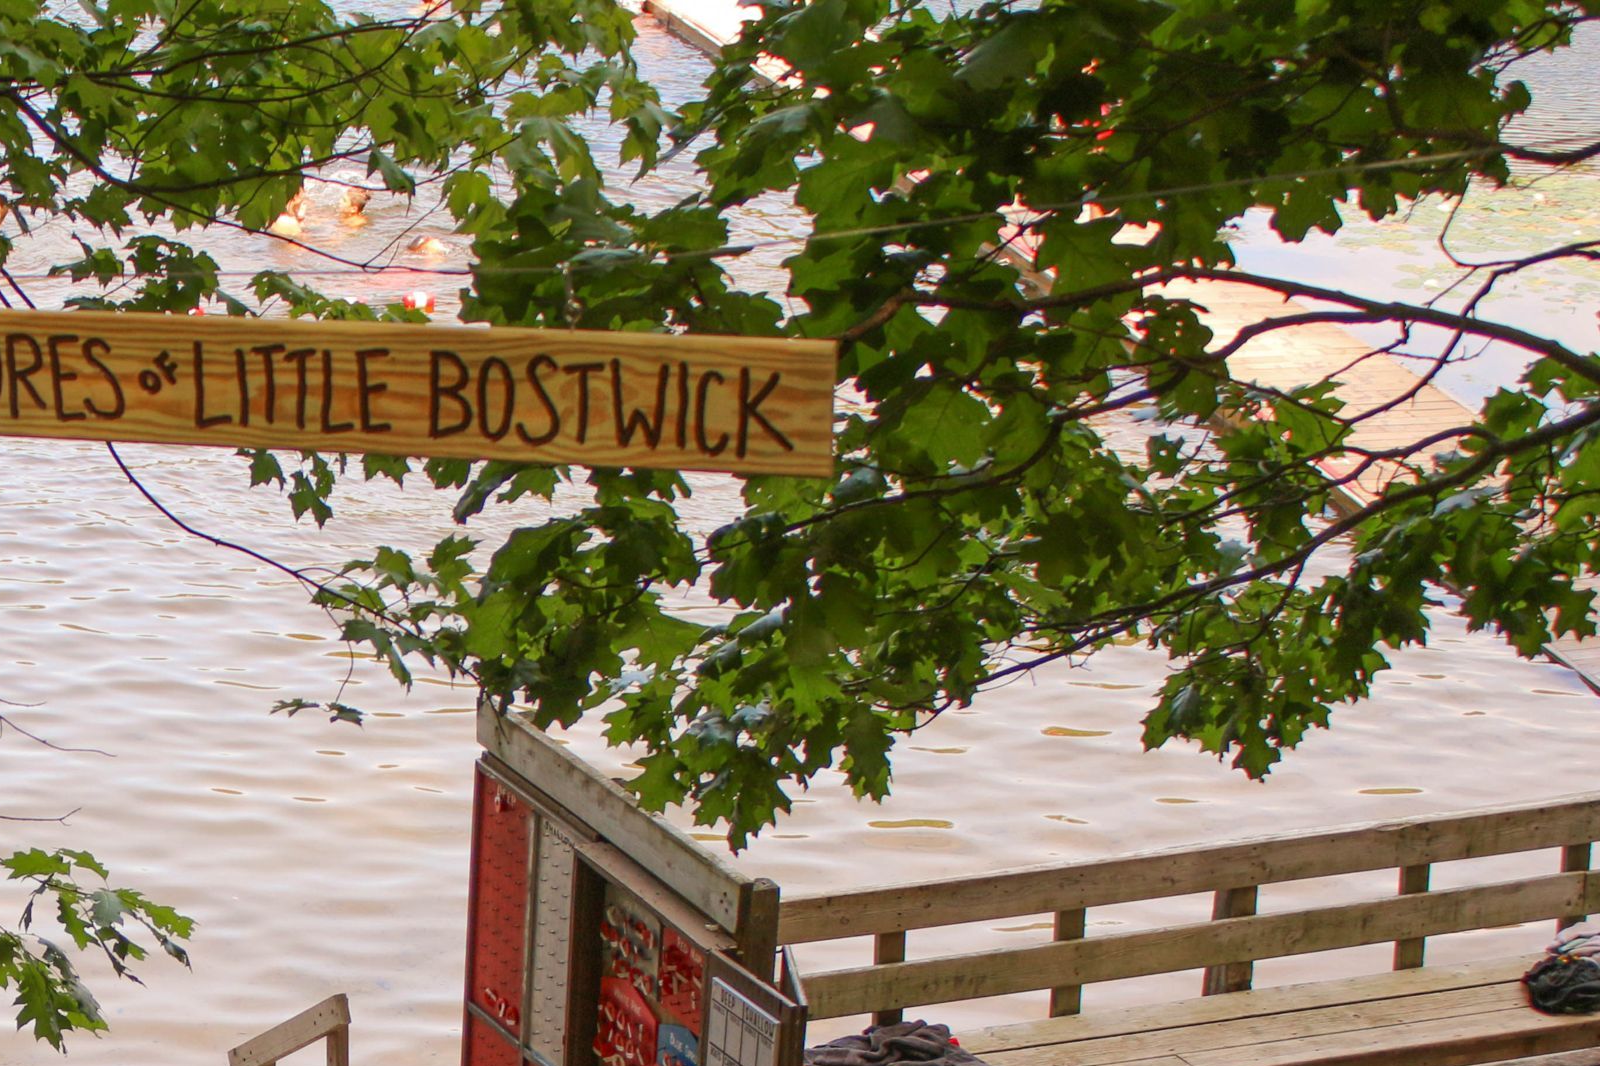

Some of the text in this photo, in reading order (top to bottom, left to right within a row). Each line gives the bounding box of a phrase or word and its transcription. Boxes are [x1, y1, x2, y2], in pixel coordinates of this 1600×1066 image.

[137, 349, 179, 396] OF
[193, 339, 393, 434] LITTLE
[428, 347, 795, 460] BOSTWICK
[720, 988, 735, 1010] DEEP
[745, 1006, 775, 1038] SHALLOW
